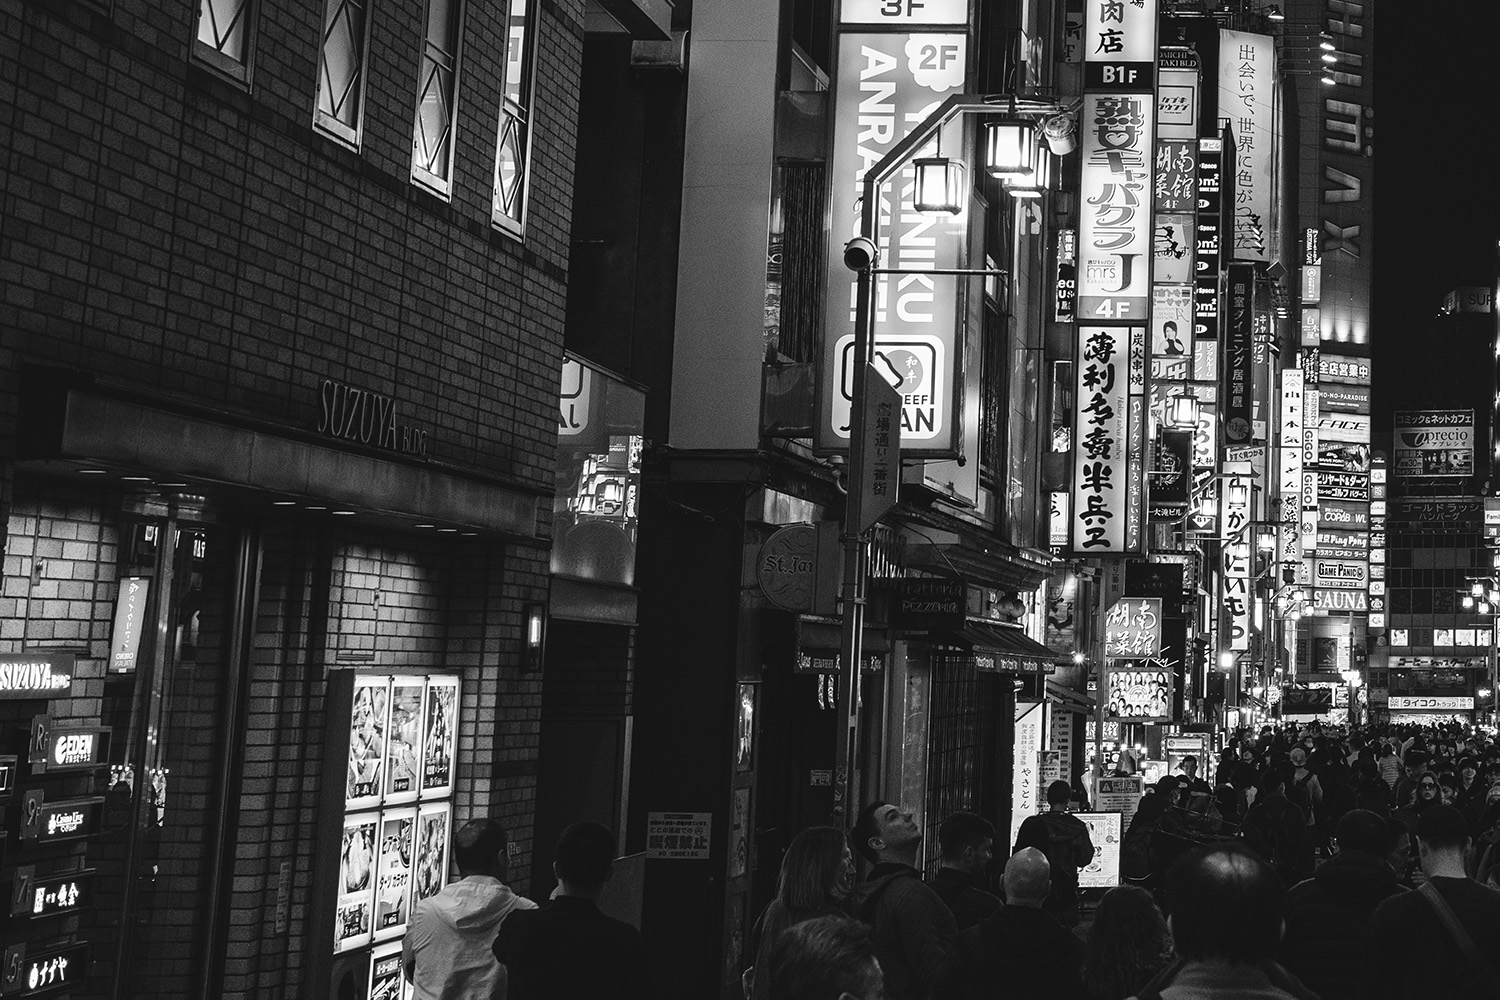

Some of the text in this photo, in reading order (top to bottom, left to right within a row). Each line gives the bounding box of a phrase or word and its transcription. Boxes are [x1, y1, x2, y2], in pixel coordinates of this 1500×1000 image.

[920, 44, 959, 70] 2F
[1103, 66, 1137, 83] B1F
[1095, 299, 1131, 318] 4F
[1129, 333, 1144, 387] 炭火串焼
[1319, 360, 1369, 379] 全店営業中
[318, 380, 428, 456] SUZUYA BLDG
[1318, 419, 1369, 431] FACE
[1304, 430, 1314, 460] GiGO
[1303, 475, 1313, 504] GiGO
[1318, 562, 1357, 577] GAME PANIC
[1313, 590, 1368, 609] SAUNA
[0, 663, 51, 690] SUZUYA
[66, 734, 93, 755] EDEN
